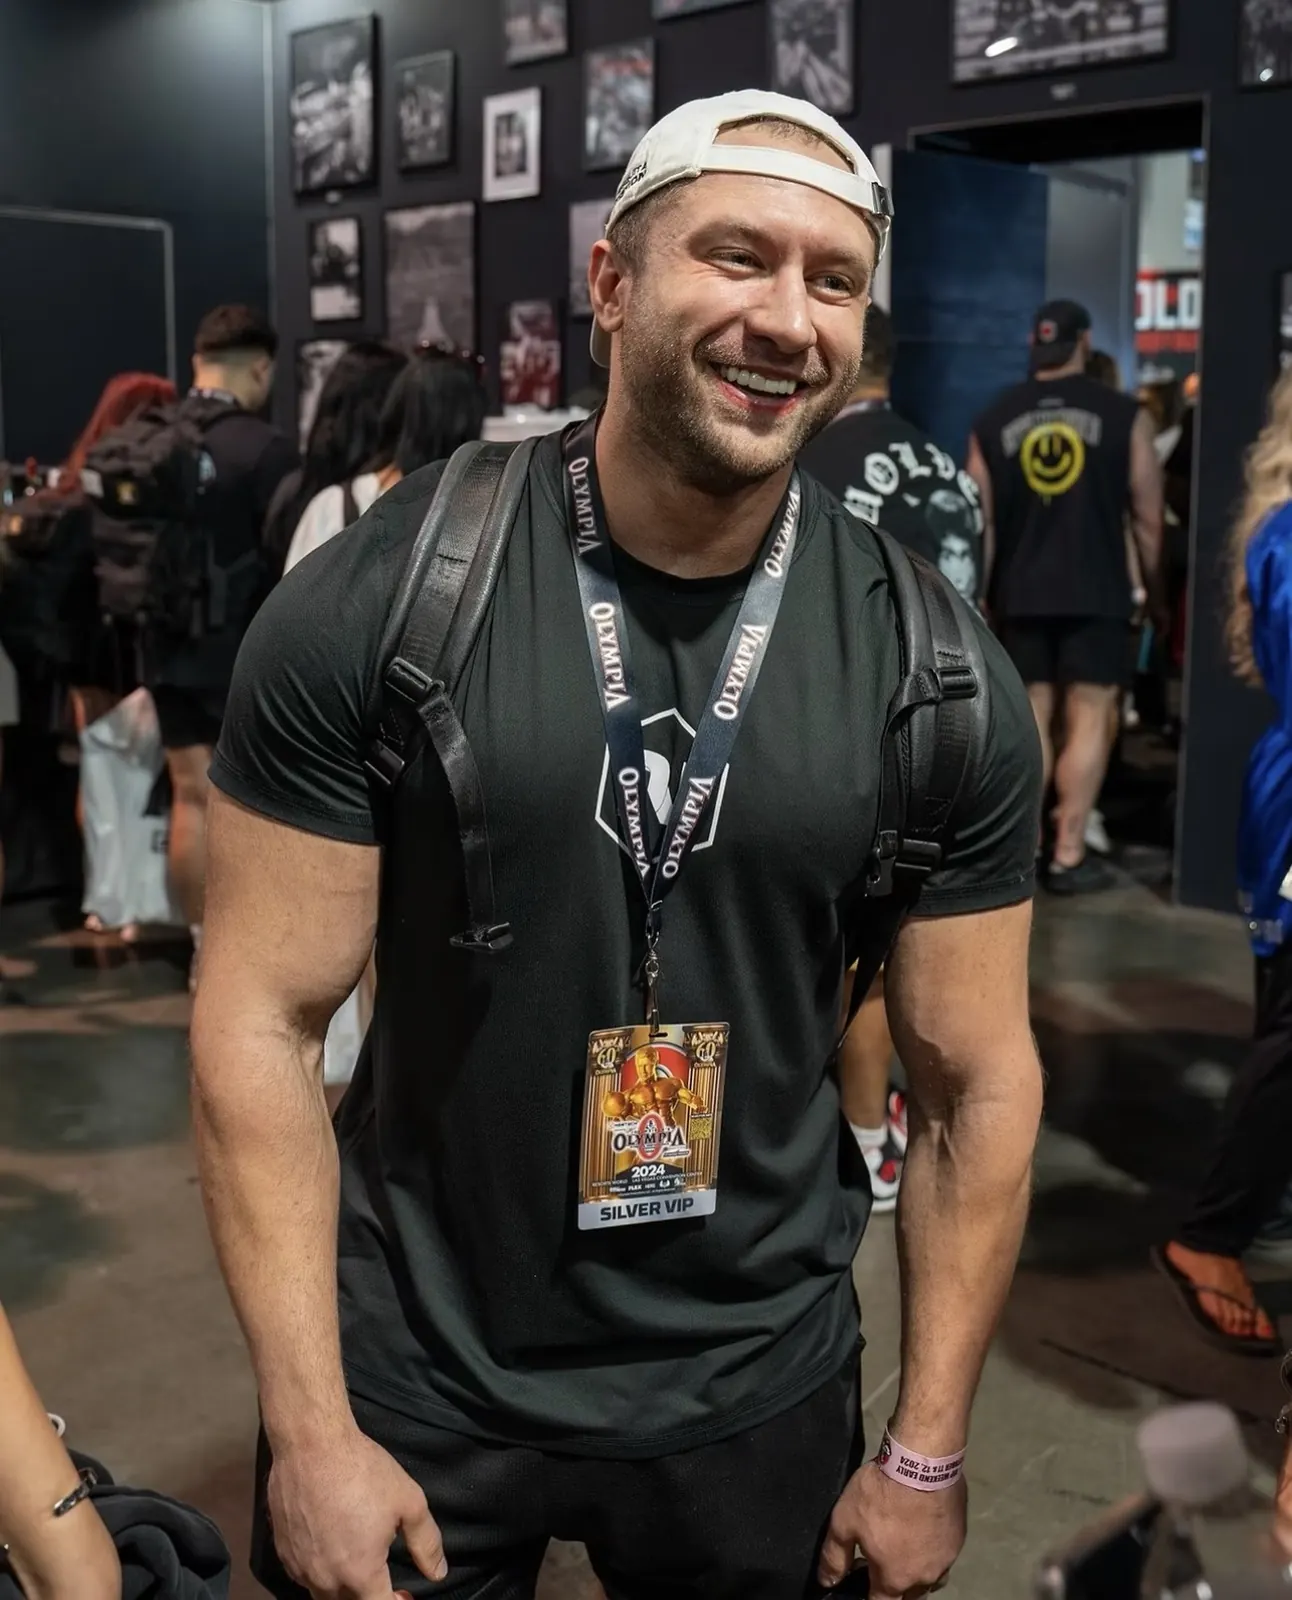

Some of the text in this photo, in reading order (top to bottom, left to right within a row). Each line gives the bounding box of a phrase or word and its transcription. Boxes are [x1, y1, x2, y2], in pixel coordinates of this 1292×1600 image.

[568, 456, 602, 556] OLYMPIA
[764, 490, 800, 578] OLYMPIA
[588, 602, 630, 711] OLYMPIA
[712, 624, 769, 720] OLYMPIA
[618, 767, 651, 879] OLYMPIA
[662, 776, 716, 878] OLYMPIA
[613, 1129, 684, 1151] OLYMPIA
[631, 1164, 665, 1178] 2024
[600, 1197, 694, 1221] SILVER VIP
[896, 1465, 919, 1480] EARLY
[900, 1456, 920, 1471] 2024
[921, 1463, 931, 1474] 12,
[938, 1465, 945, 1473] 11
[919, 1472, 949, 1484] WEEKEND
